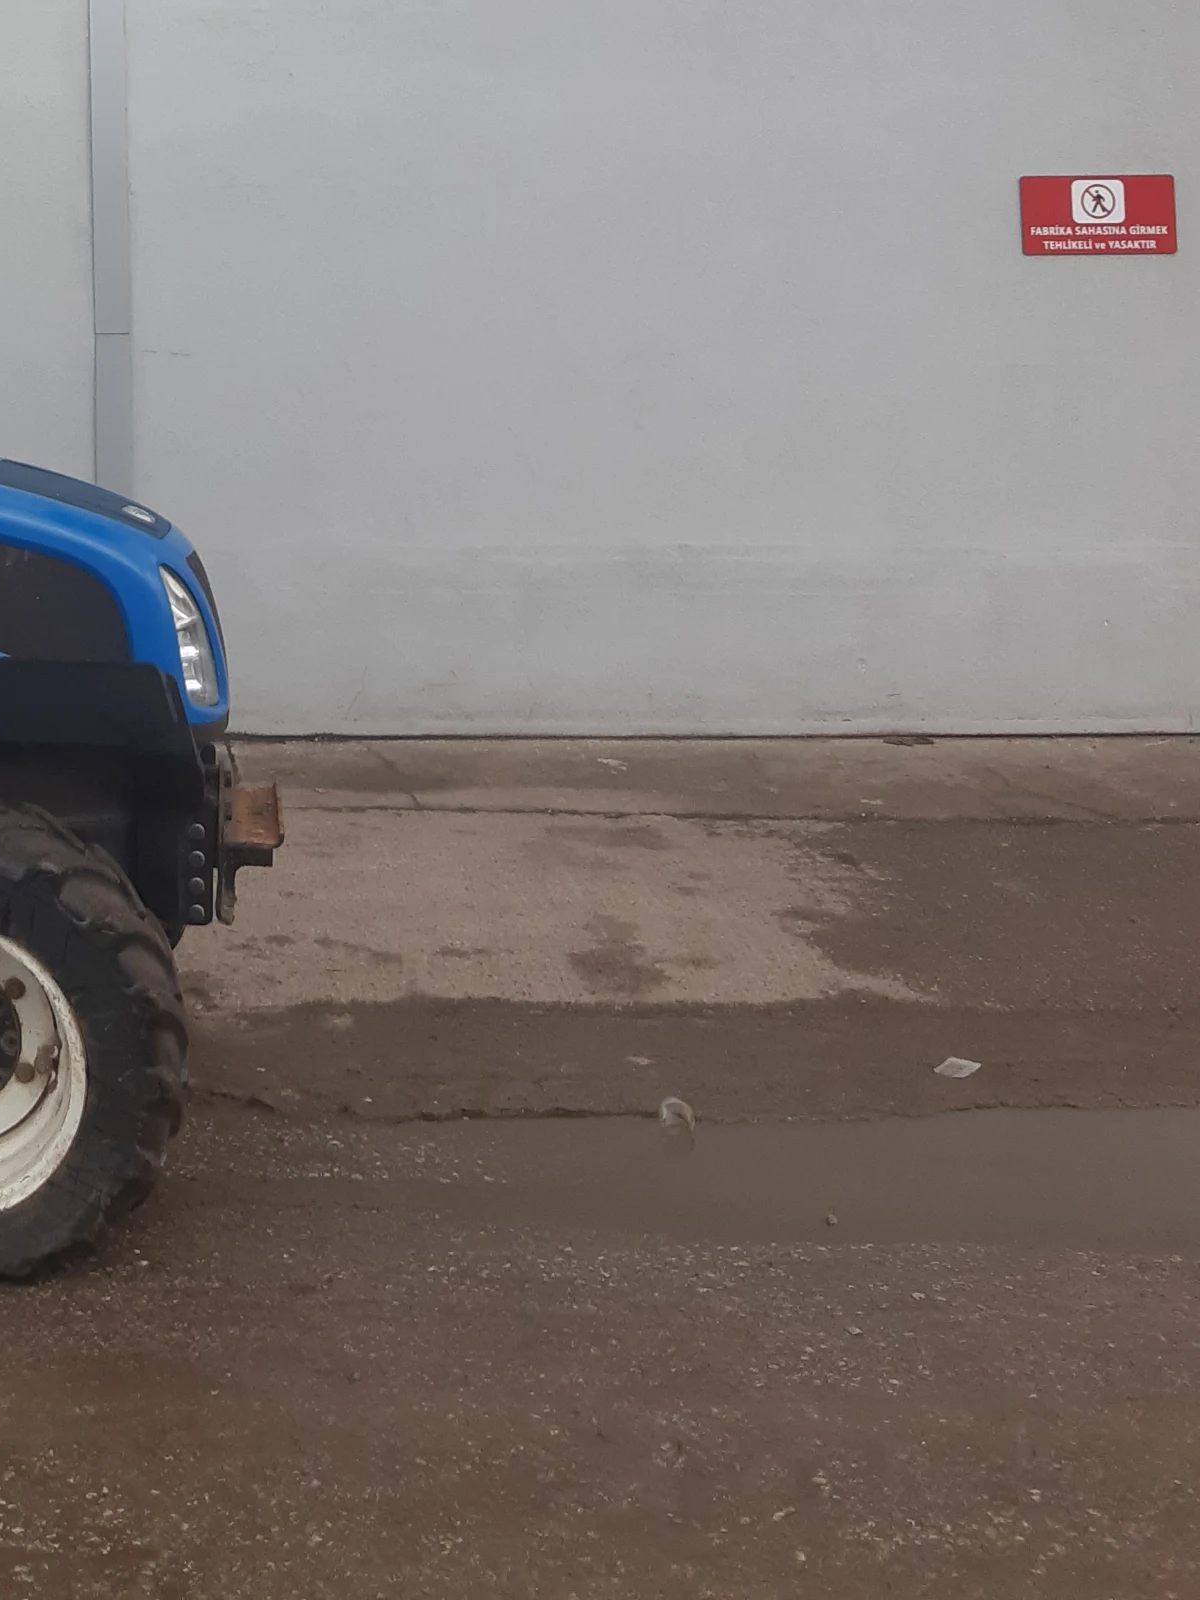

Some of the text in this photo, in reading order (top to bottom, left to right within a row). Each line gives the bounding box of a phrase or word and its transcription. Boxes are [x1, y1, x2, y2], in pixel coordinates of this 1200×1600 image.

[1030, 223, 1168, 235] FABRİKA SAHASINA GİRMEK
[1042, 238, 1157, 250] TEHLİKELİ ve YASAKTIR
